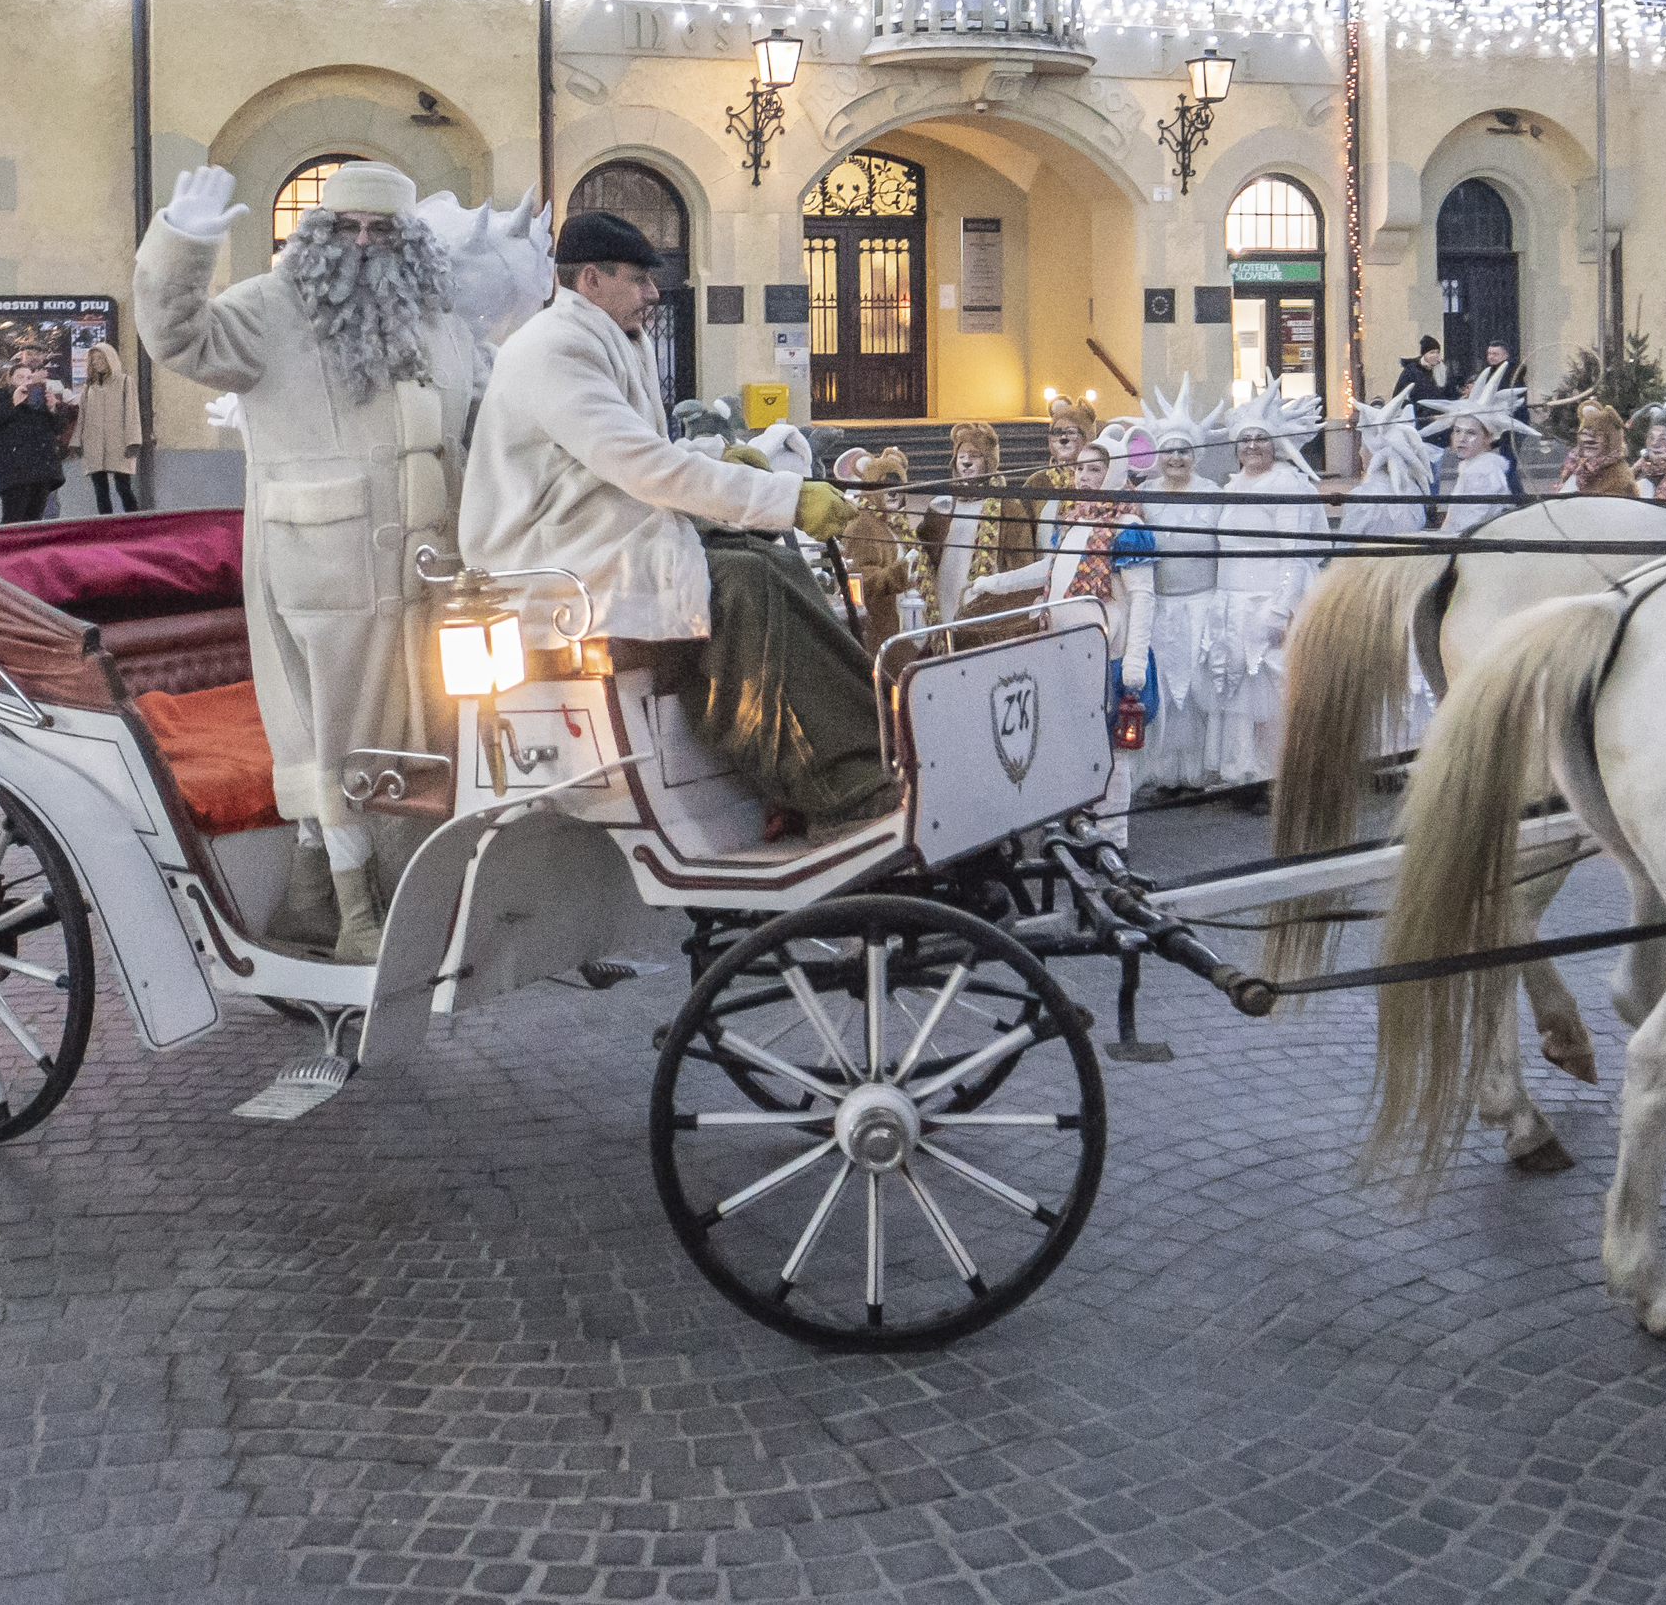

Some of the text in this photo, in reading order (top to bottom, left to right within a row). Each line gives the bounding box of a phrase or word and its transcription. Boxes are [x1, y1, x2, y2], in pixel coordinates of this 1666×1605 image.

[1238, 263, 1279, 272] LOTERIJA
[1235, 271, 1283, 280] SLOVENIJE
[1002, 689, 1031, 736] ZK
